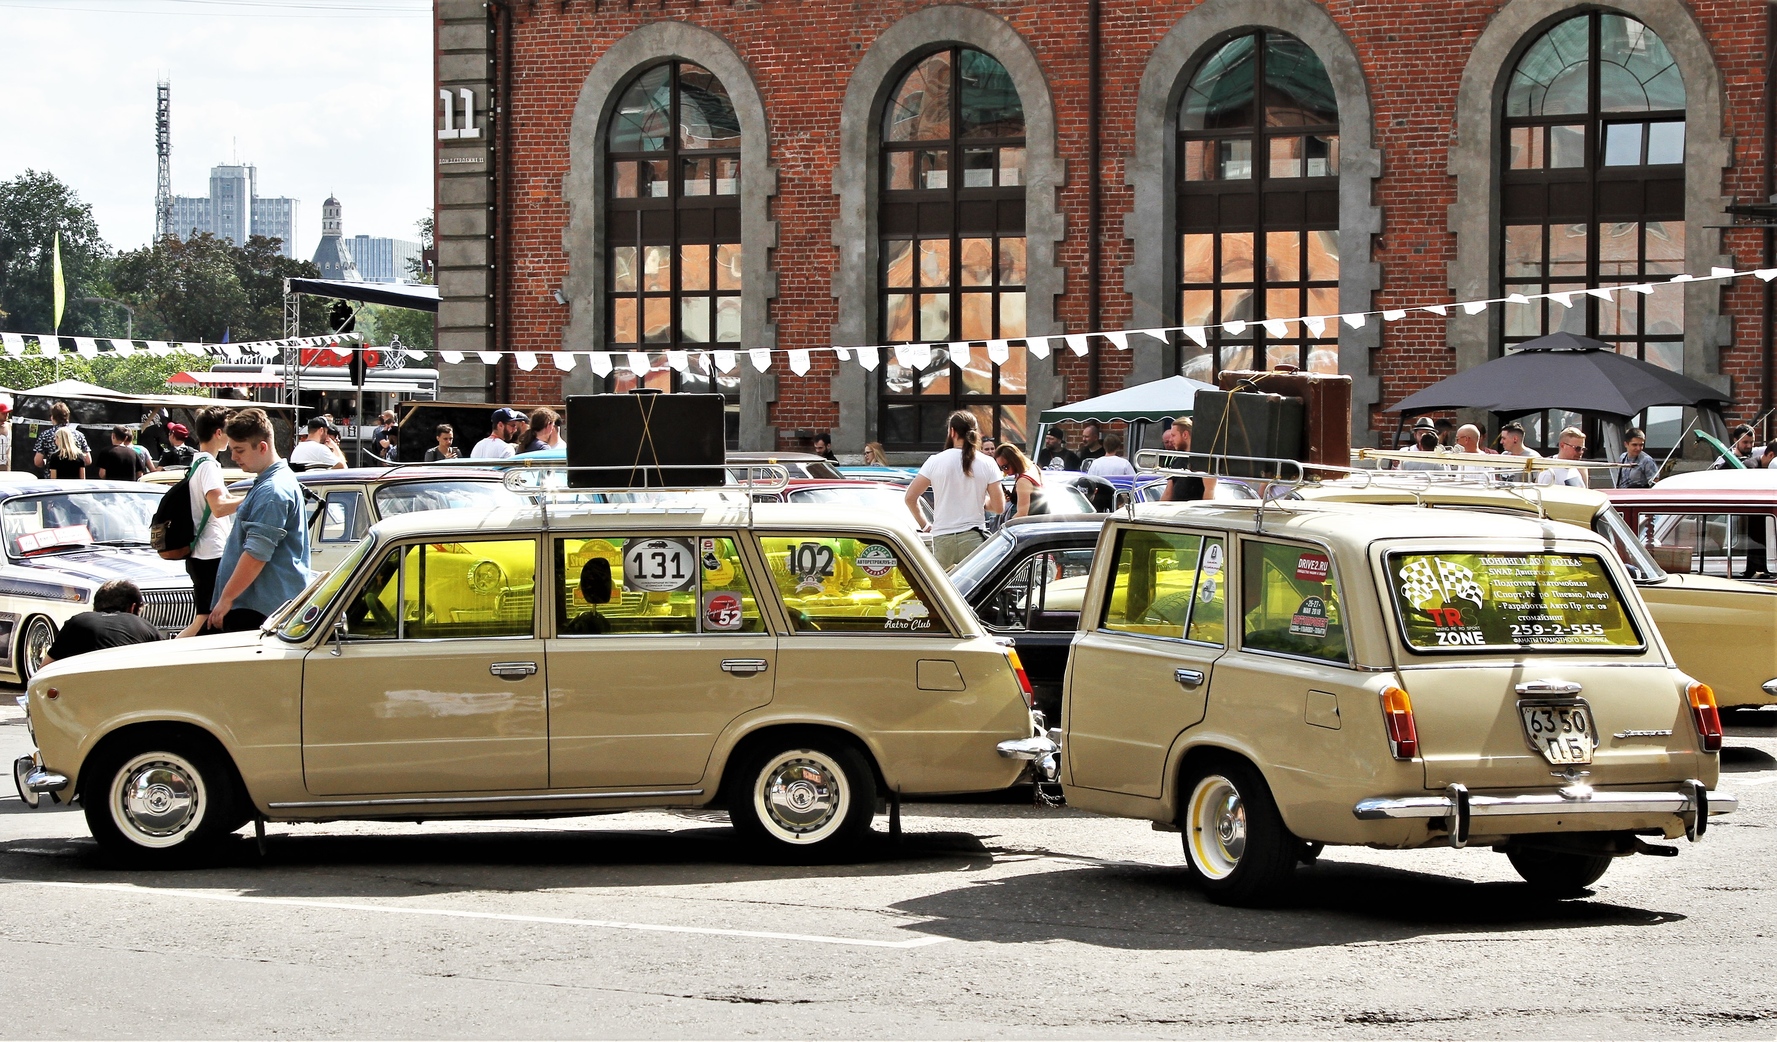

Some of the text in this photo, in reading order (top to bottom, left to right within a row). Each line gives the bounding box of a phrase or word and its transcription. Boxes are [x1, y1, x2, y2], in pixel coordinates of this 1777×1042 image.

[438, 88, 480, 140] 11
[633, 552, 685, 579] 131
[787, 544, 834, 576] 102
[1298, 558, 1328, 571] DRIVE2.RU
[1525, 591, 1549, 599] Реро
[719, 610, 741, 625] 52
[884, 619, 931, 631] Retro Club
[1510, 624, 1604, 635] 259-2-555
[1435, 631, 1486, 646] ZONE
